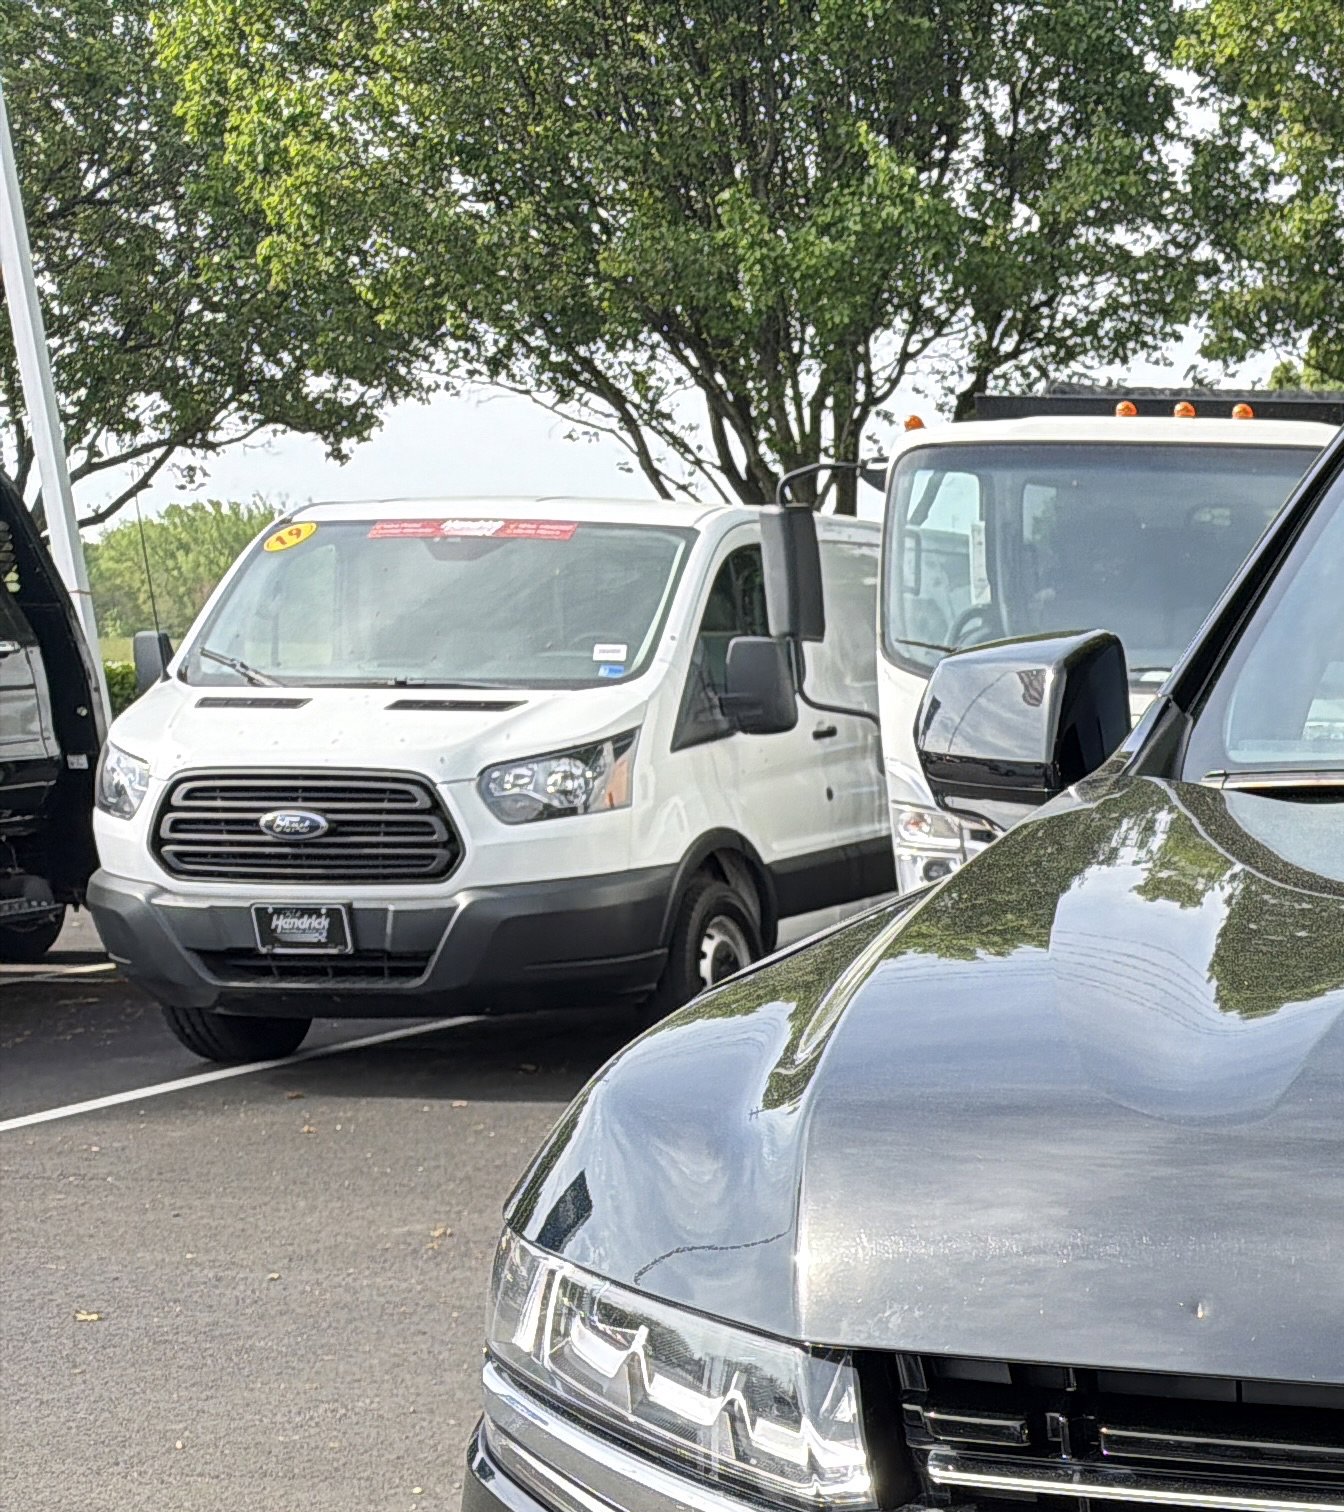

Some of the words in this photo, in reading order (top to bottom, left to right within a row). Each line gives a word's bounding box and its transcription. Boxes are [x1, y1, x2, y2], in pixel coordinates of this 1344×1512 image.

[275, 527, 302, 545] 19
[272, 815, 311, 833] Ford
[271, 913, 331, 934] Hendrick
